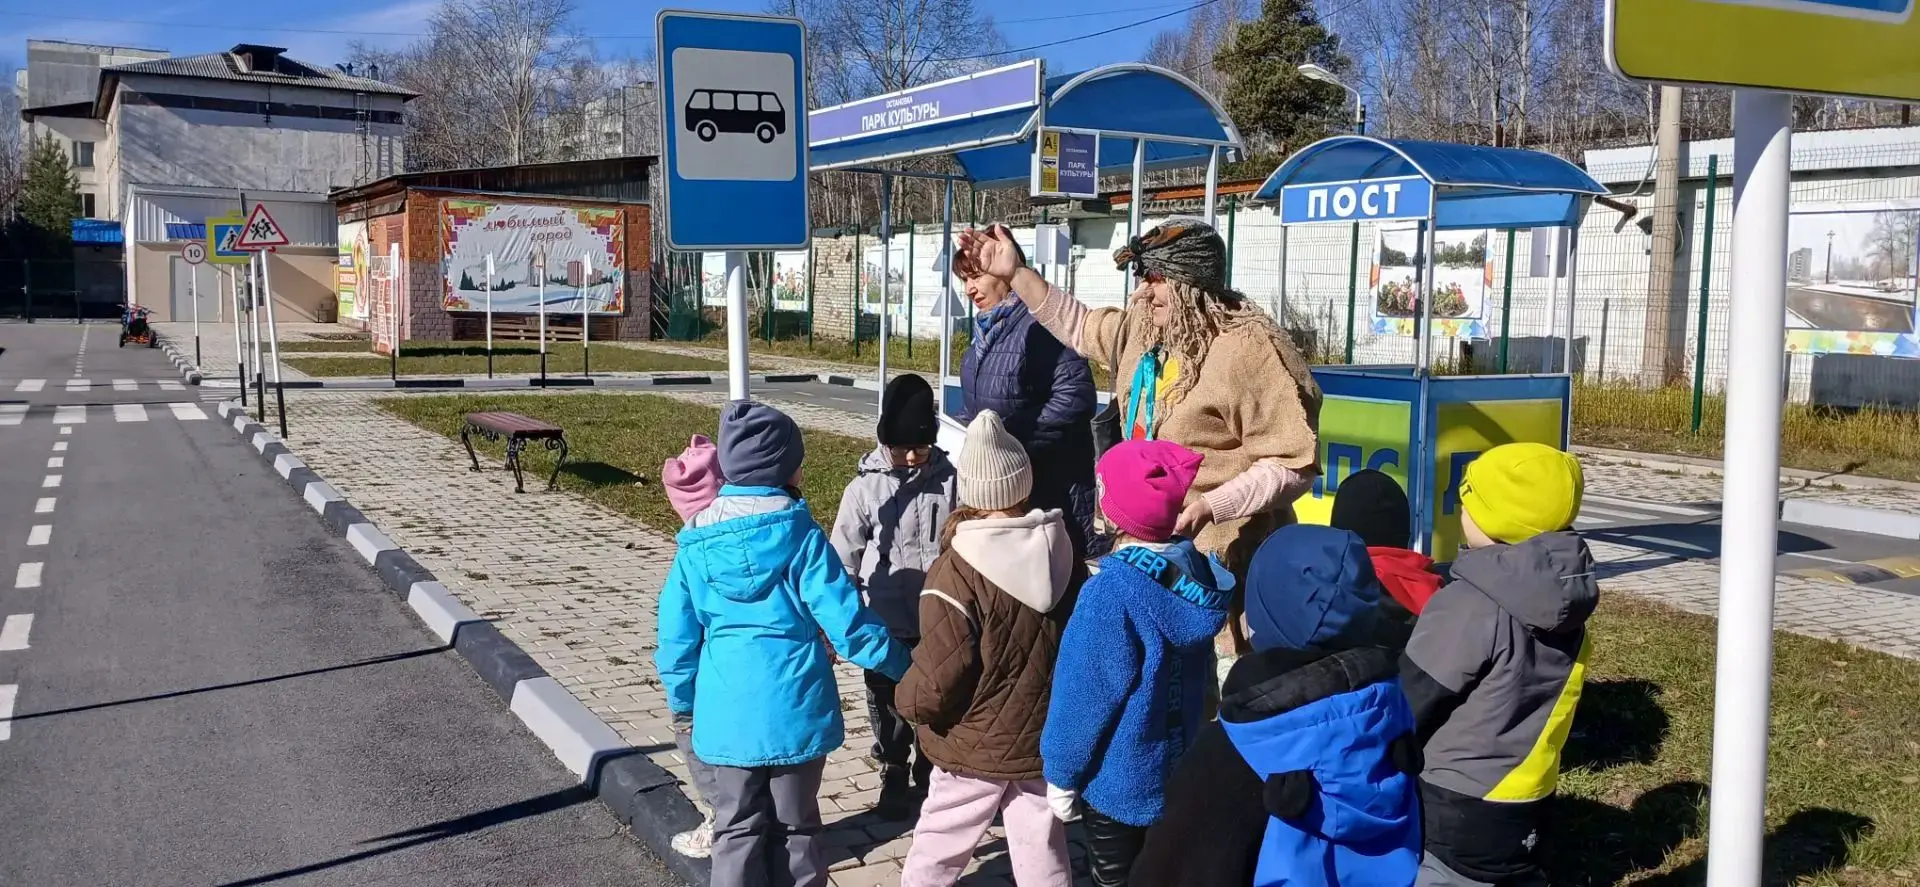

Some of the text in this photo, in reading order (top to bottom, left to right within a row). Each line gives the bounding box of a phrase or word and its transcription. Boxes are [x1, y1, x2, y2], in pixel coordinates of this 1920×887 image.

[886, 96, 913, 108] ОСТАНОВКА
[861, 100, 940, 131] ПАРК КУЛЬТУРЫ
[1068, 161, 1086, 169] ПАРК
[1060, 169, 1094, 178] КУЛЬТУРЫ
[1307, 183, 1401, 218] ПОСТ
[530, 227, 573, 244] город
[188, 248, 201, 258] 10
[1312, 442, 1399, 499] ПС
